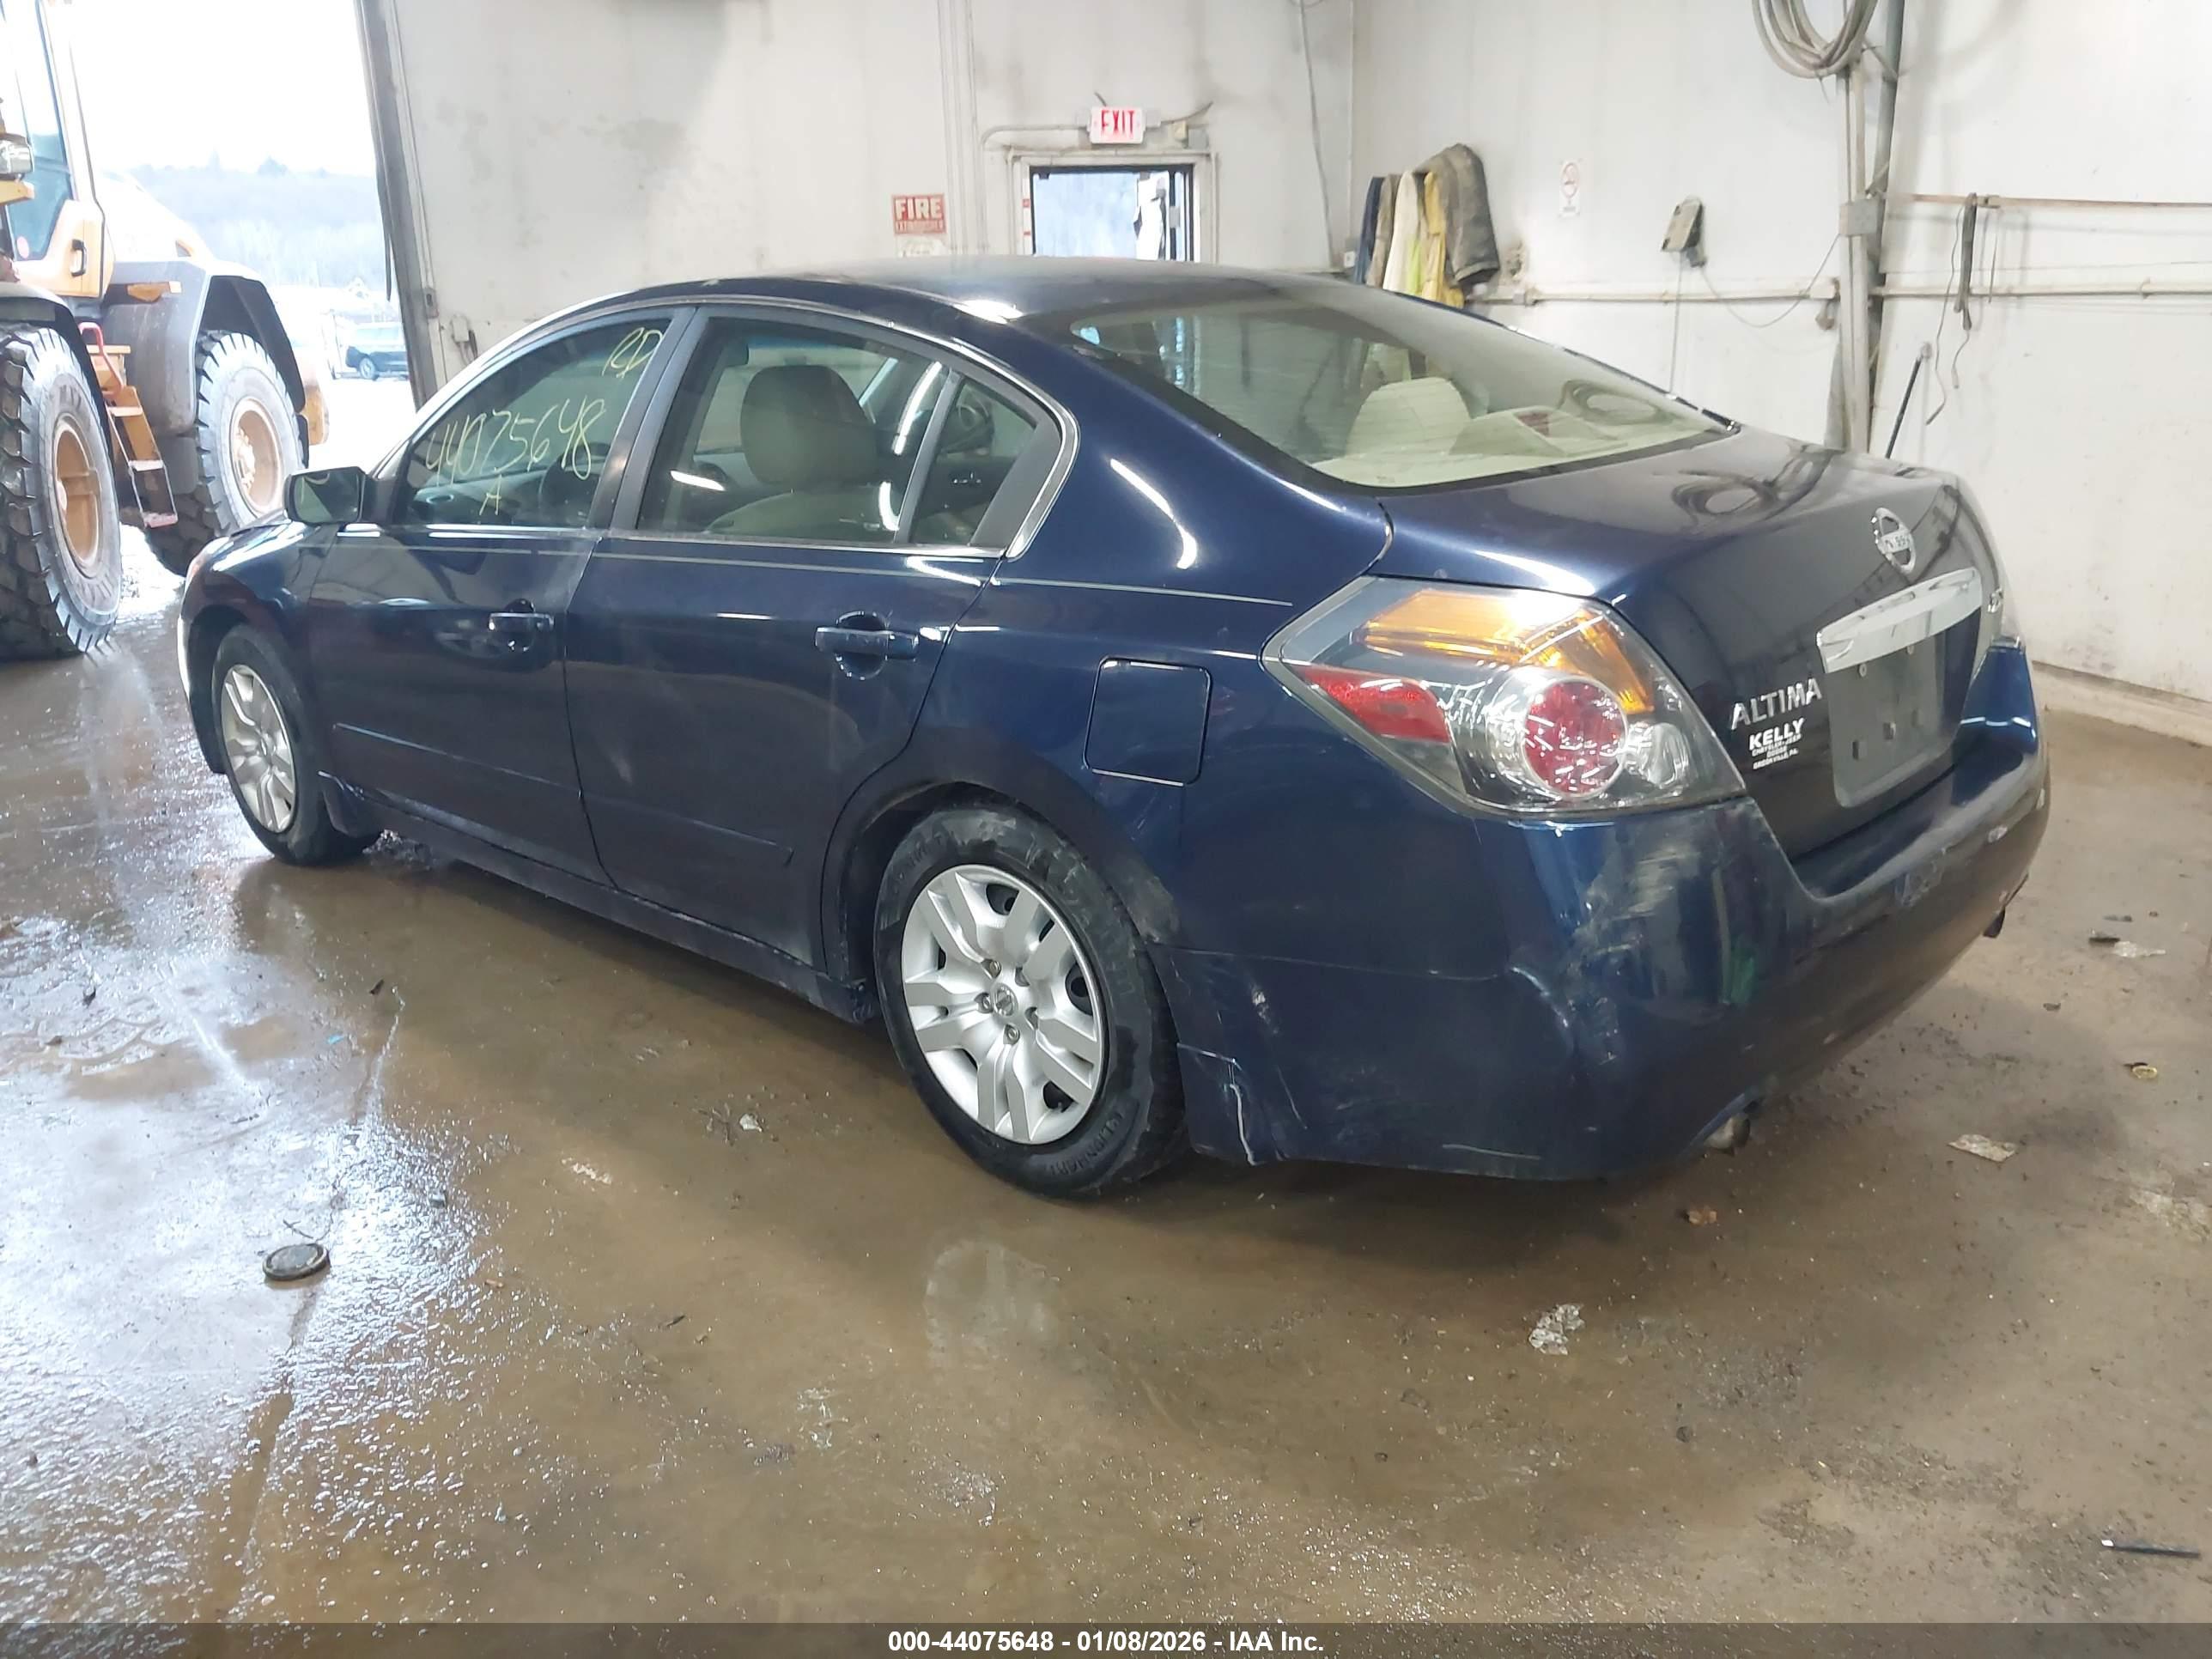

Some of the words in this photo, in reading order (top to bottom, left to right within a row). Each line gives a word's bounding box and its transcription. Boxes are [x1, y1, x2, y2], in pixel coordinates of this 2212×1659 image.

[1101, 110, 1134, 134] EXIT
[895, 198, 943, 220] FIRE
[425, 395, 605, 487] 44075648
[1731, 678, 1822, 730] ALTIMA
[1749, 717, 1805, 750] KELLY
